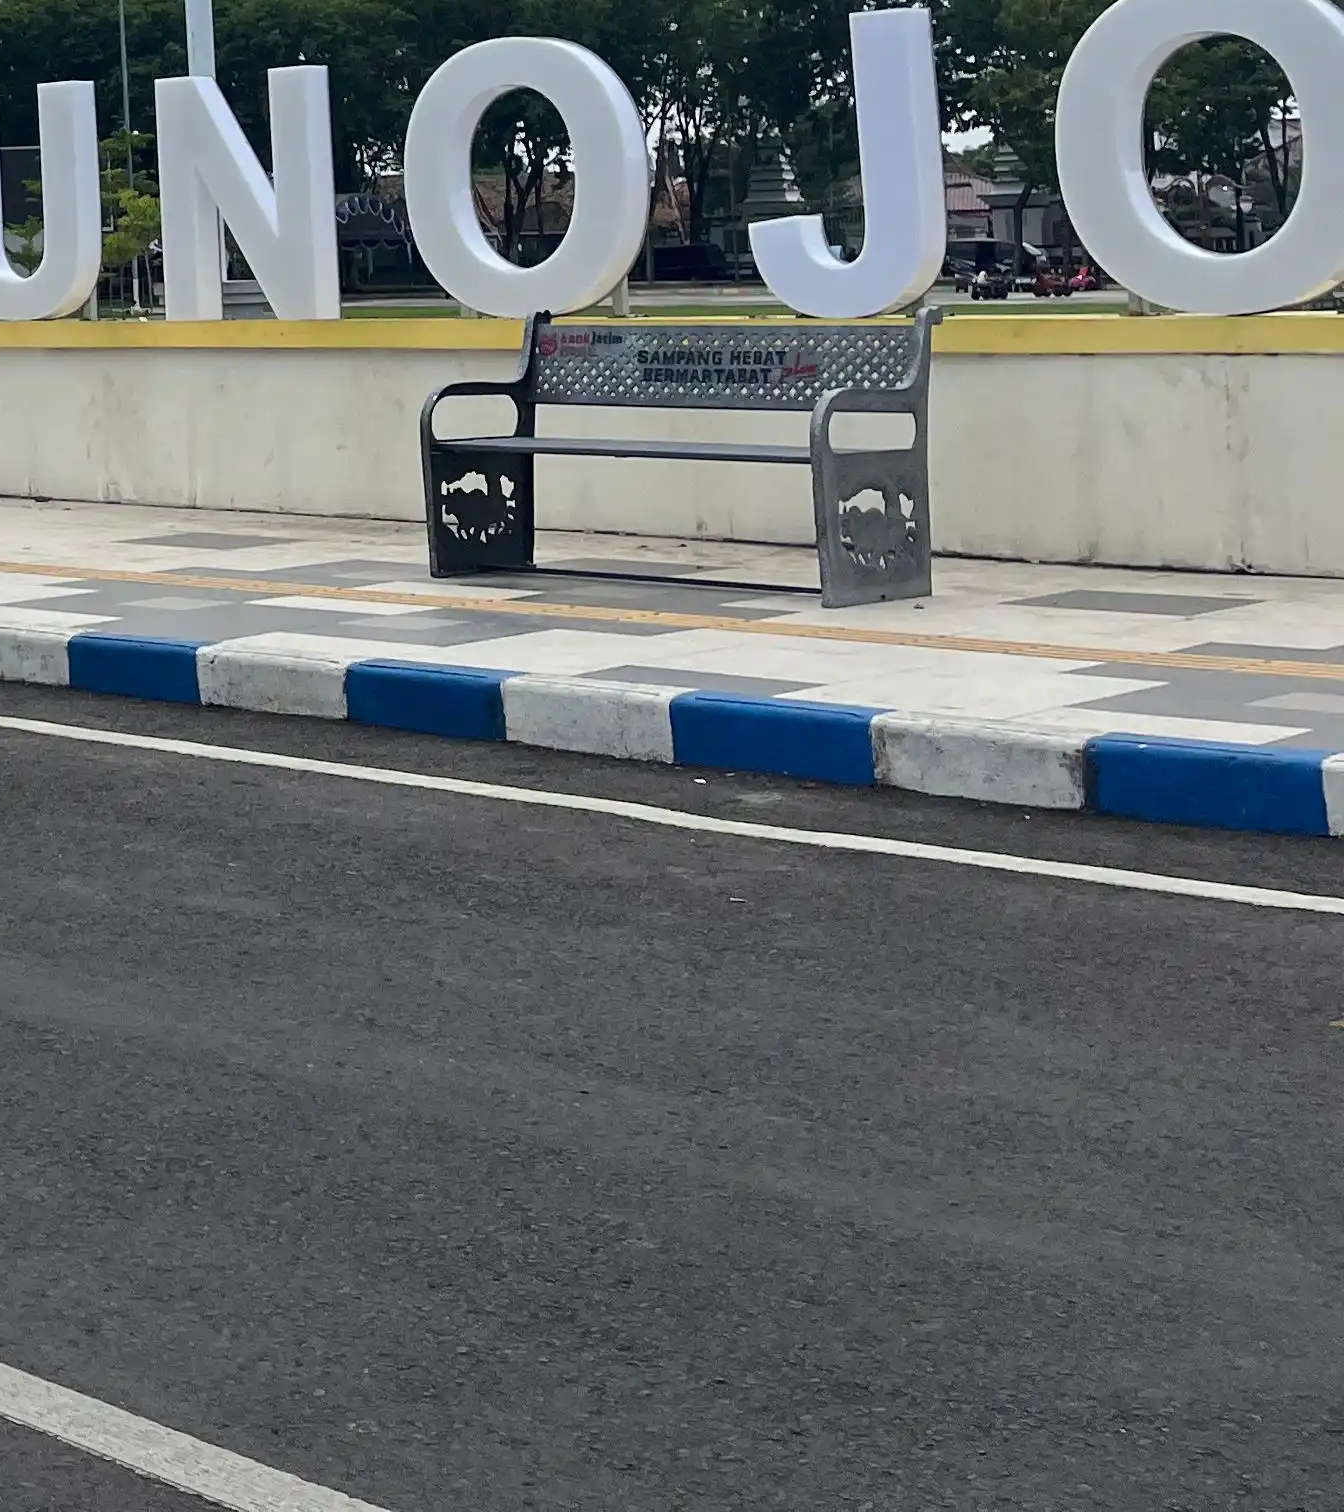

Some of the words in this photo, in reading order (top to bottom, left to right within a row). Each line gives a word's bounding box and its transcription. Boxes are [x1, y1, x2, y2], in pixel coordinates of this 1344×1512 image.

[636, 350, 723, 365] SAMPANG
[730, 350, 787, 365] HEBAT
[643, 368, 772, 384] BERMARTABAT
